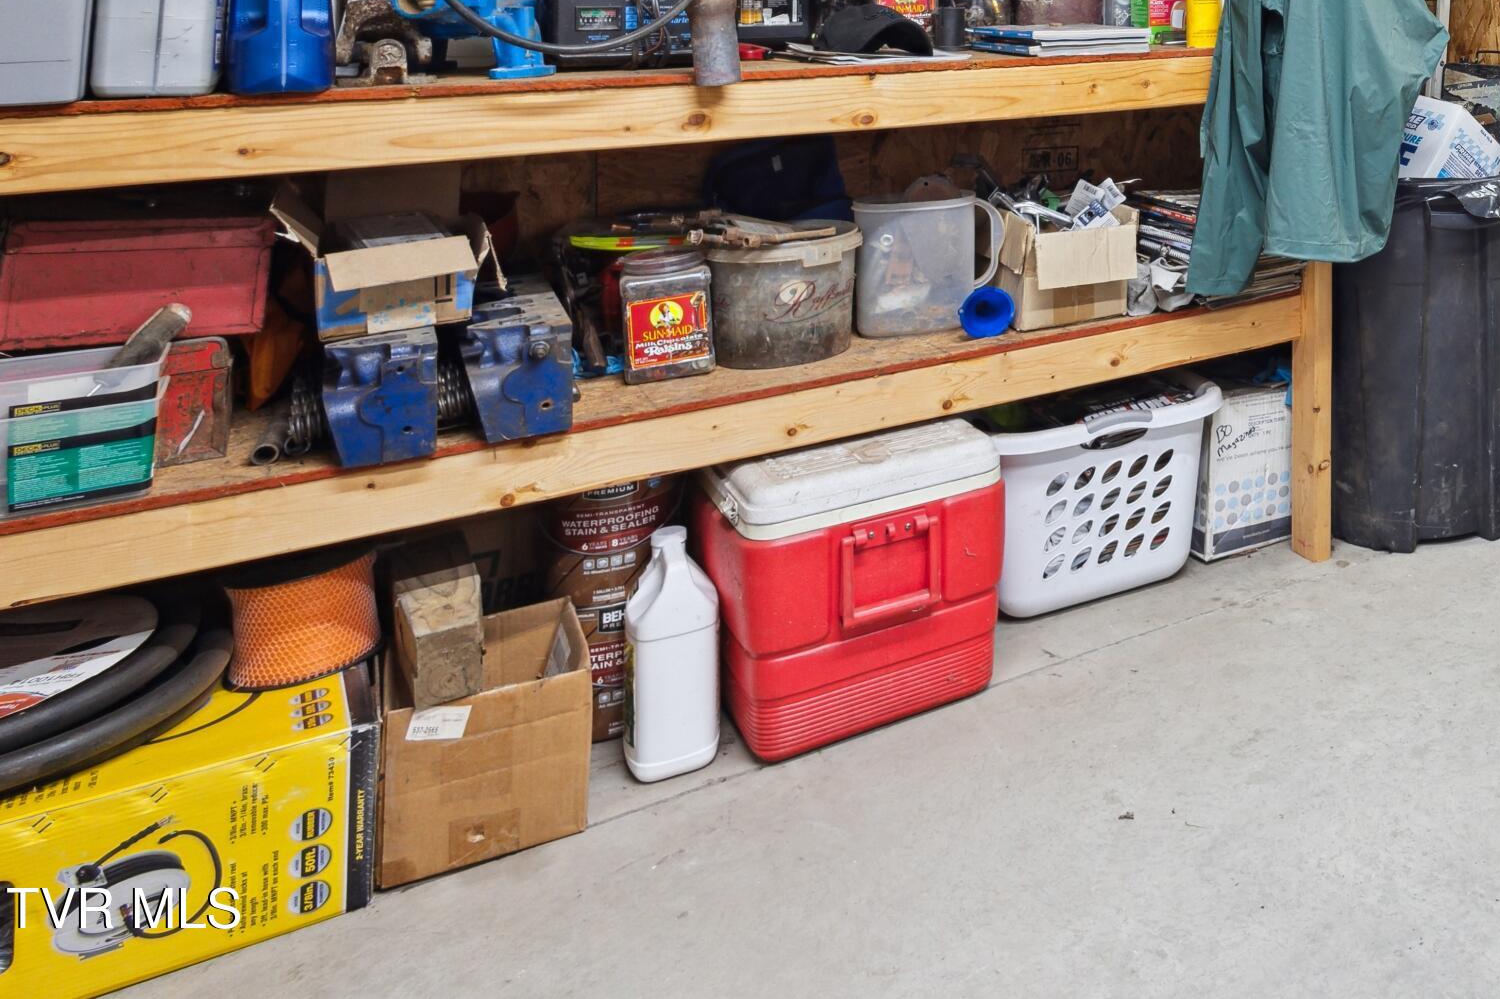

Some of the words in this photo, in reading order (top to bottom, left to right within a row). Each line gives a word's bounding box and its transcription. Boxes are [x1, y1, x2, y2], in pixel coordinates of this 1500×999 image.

[643, 325, 693, 342] SUN-MAID
[644, 342, 693, 357] Raisins
[587, 484, 634, 497] PREMIUM
[561, 505, 659, 528] WATERPROOFING
[576, 503, 645, 518] SEMI-TRANSPARENT
[565, 525, 597, 536] STAIN
[600, 525, 608, 534] &
[611, 515, 656, 532] SEALER
[582, 542, 588, 551] 6
[611, 538, 619, 547] 8
[592, 660, 613, 670] AIN
[597, 676, 603, 684] 6
[356, 789, 365, 831] WARRANTY
[249, 805, 258, 834] removable
[356, 832, 364, 860] 2-YEAR
[304, 848, 315, 873] 50ft.
[249, 897, 258, 914] length
[303, 883, 315, 911] 3/8in.
